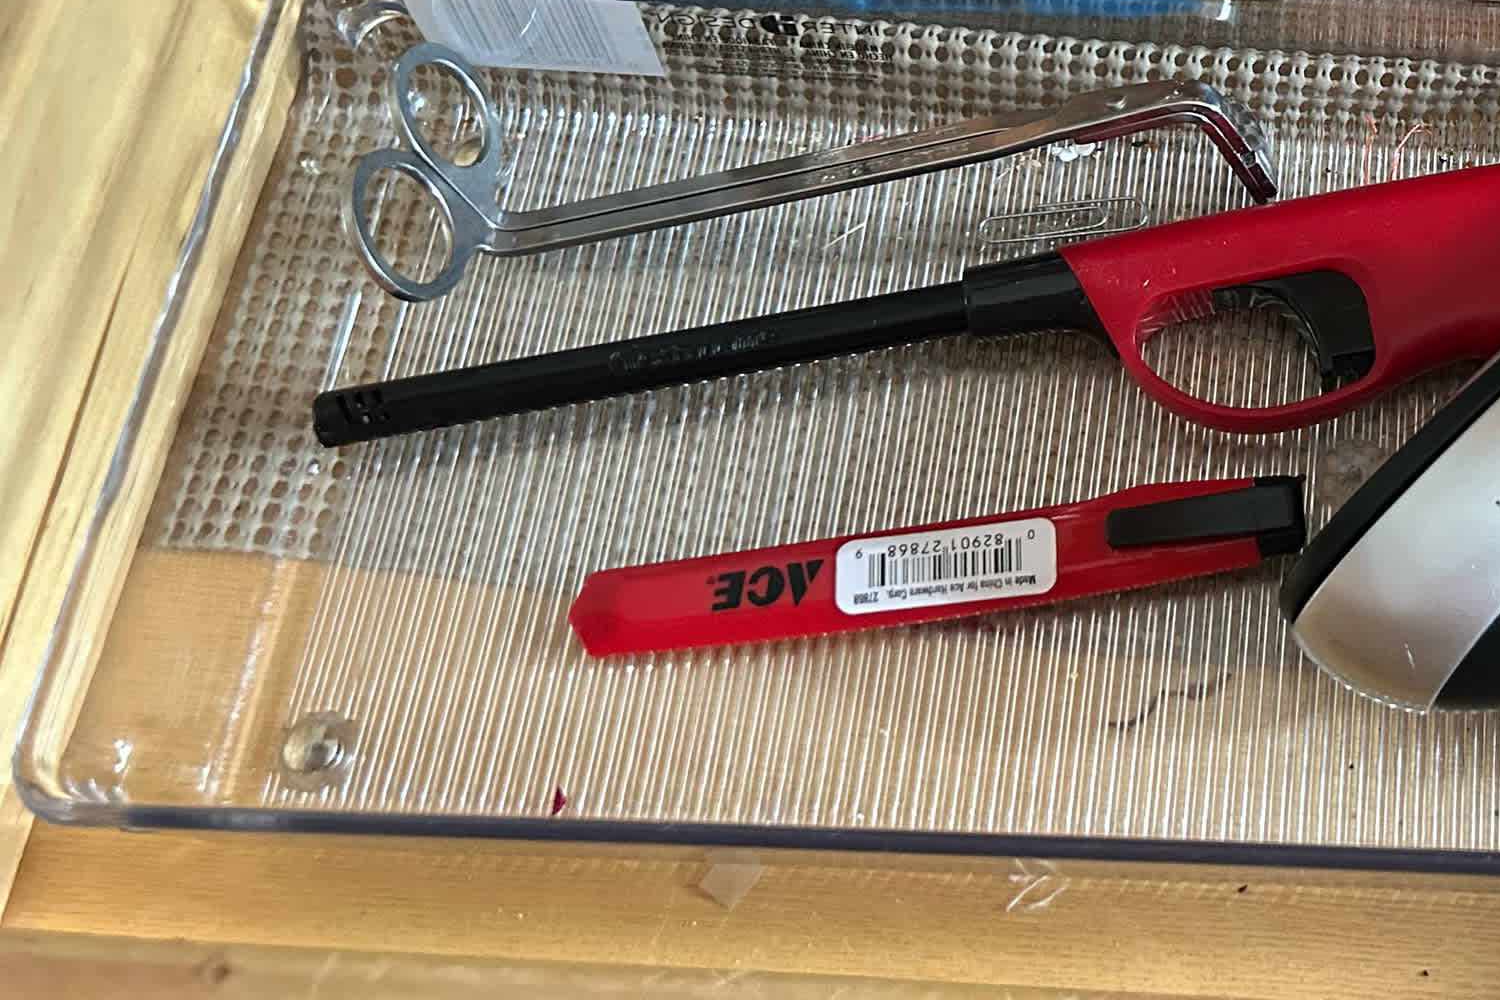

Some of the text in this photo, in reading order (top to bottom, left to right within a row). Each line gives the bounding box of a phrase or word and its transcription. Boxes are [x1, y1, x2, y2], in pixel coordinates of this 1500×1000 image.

[855, 528, 1036, 560] 0 82901 27868 9
[711, 559, 825, 612] ACE
[967, 581, 979, 592] for
[979, 579, 1004, 591] China
[1005, 578, 1013, 588] in
[1015, 574, 1037, 587] Made
[885, 588, 908, 601] Corp.
[909, 585, 949, 598] Hardware
[950, 583, 966, 594] Ace
